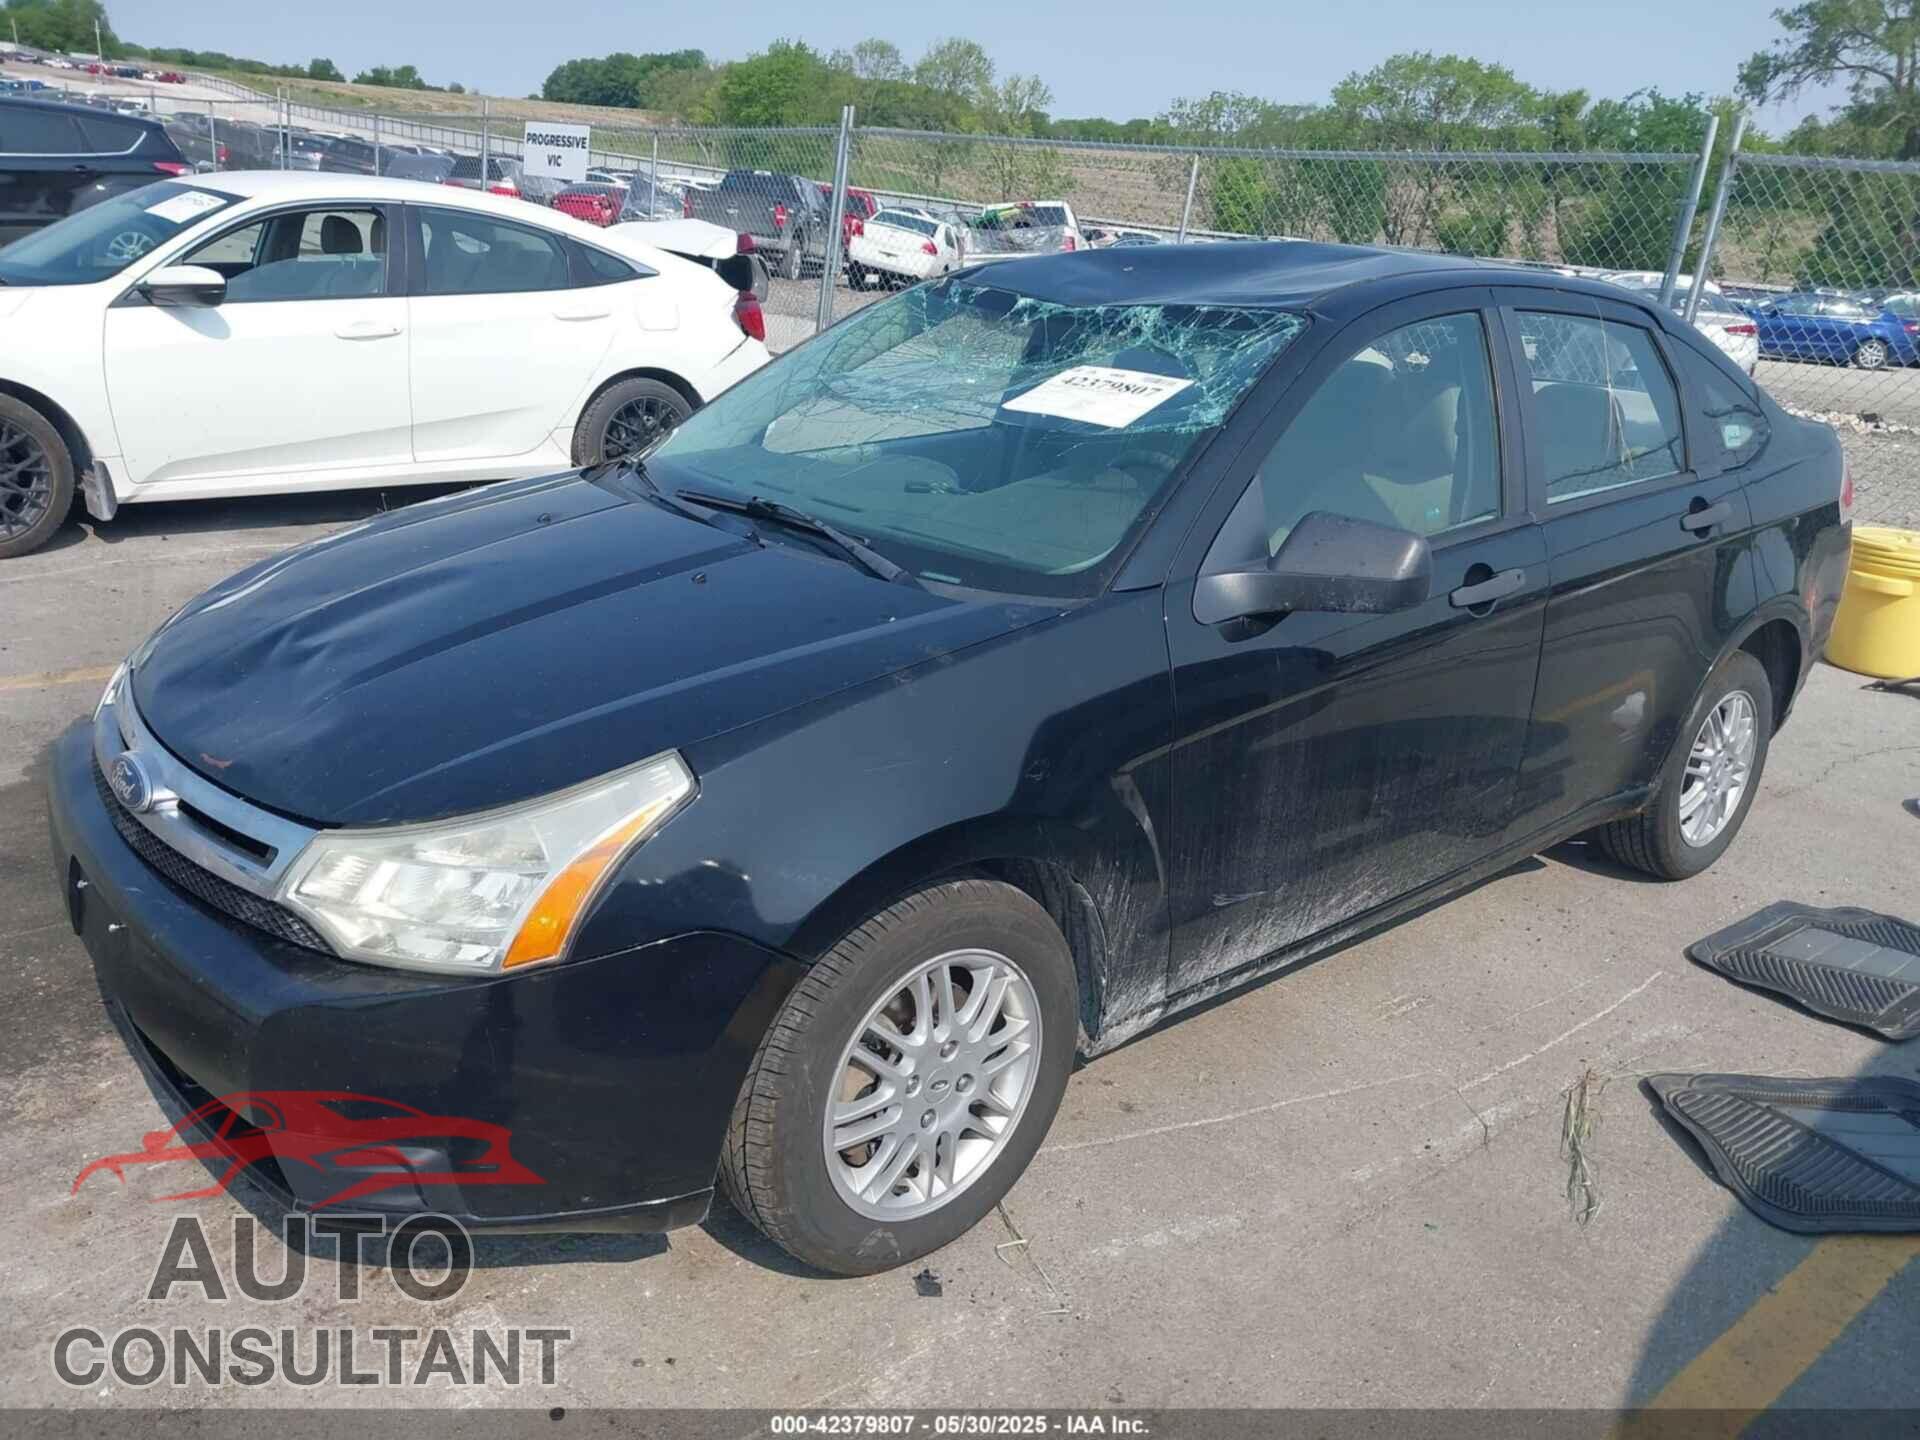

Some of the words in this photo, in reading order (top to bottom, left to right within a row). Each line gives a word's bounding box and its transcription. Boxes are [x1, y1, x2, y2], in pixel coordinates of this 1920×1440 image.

[527, 133, 587, 149] PROGRESSIVE
[547, 154, 562, 167] VIC
[1062, 375, 1163, 397] 42379807
[112, 760, 136, 800] Ford
